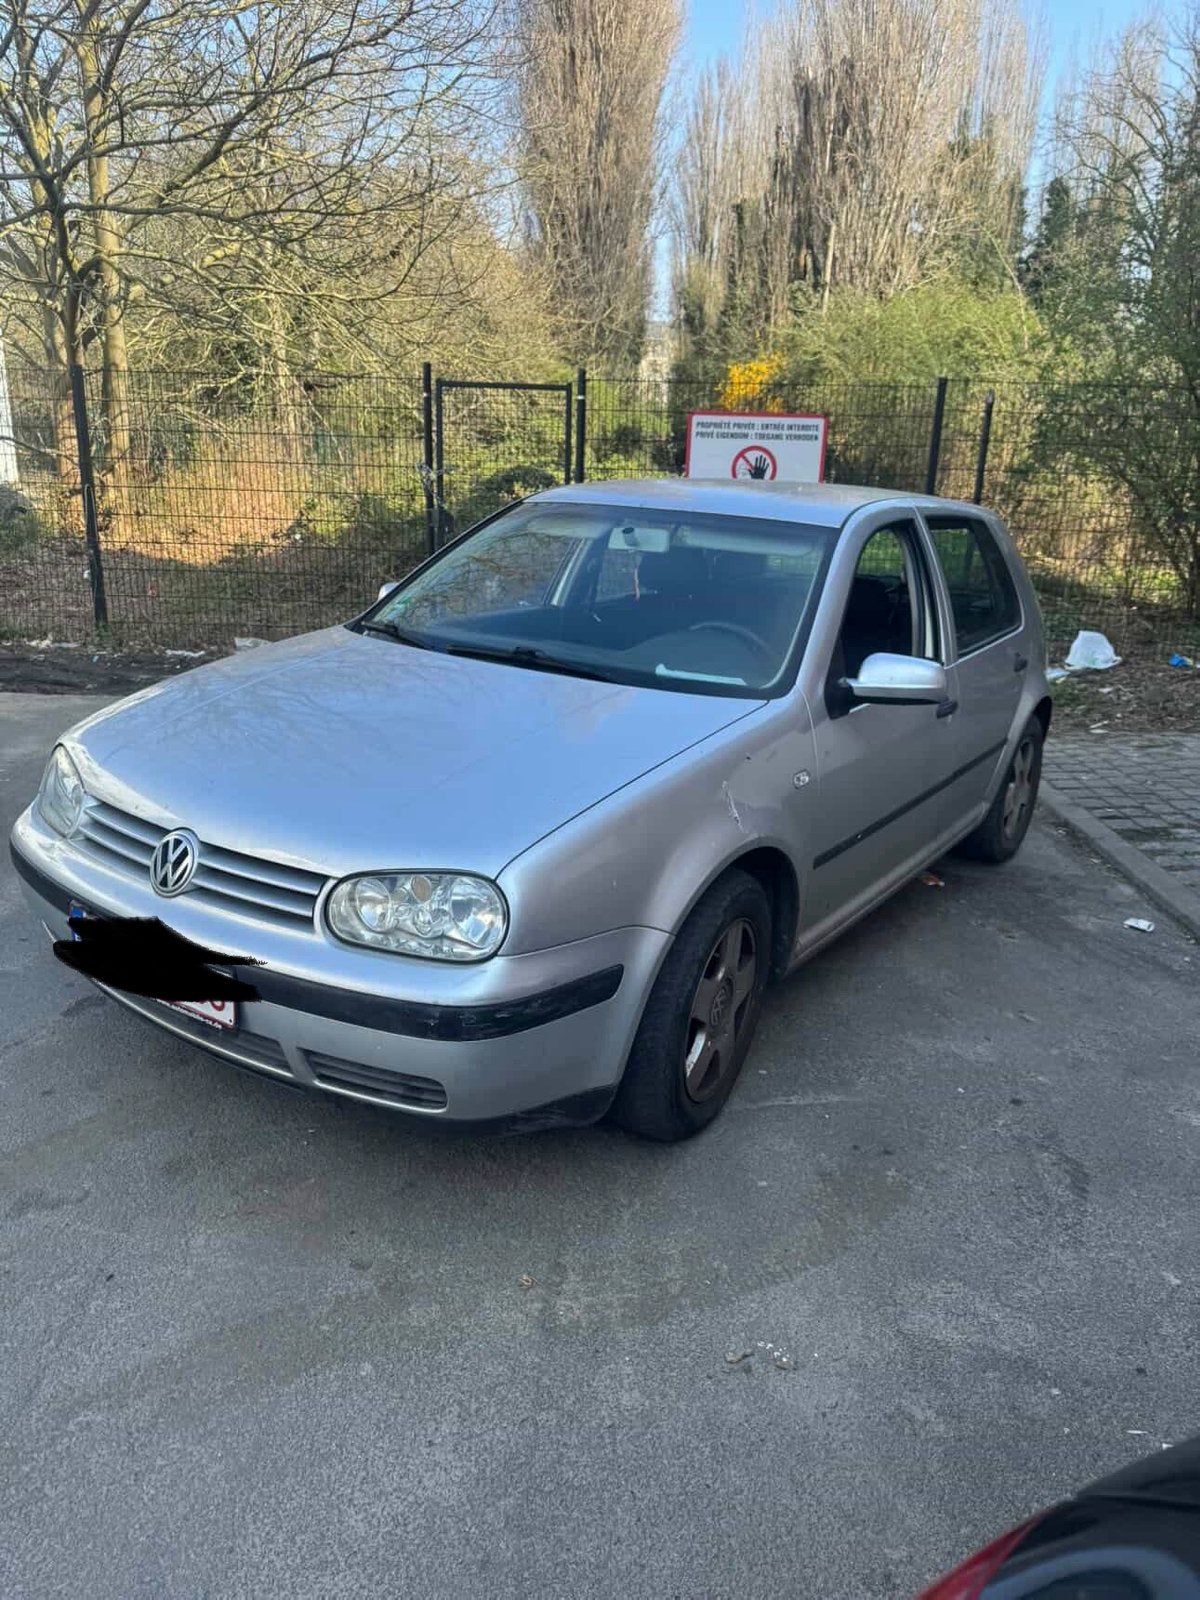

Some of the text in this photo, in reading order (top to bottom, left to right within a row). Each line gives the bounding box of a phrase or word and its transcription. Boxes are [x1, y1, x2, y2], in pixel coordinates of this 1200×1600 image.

[696, 420, 731, 430] PROPRIÉTÉ
[733, 421, 755, 430] PRIVÉE
[761, 422, 785, 431] ENTRÉE
[786, 423, 819, 432] INTERDITE
[152, 832, 196, 895] VW
